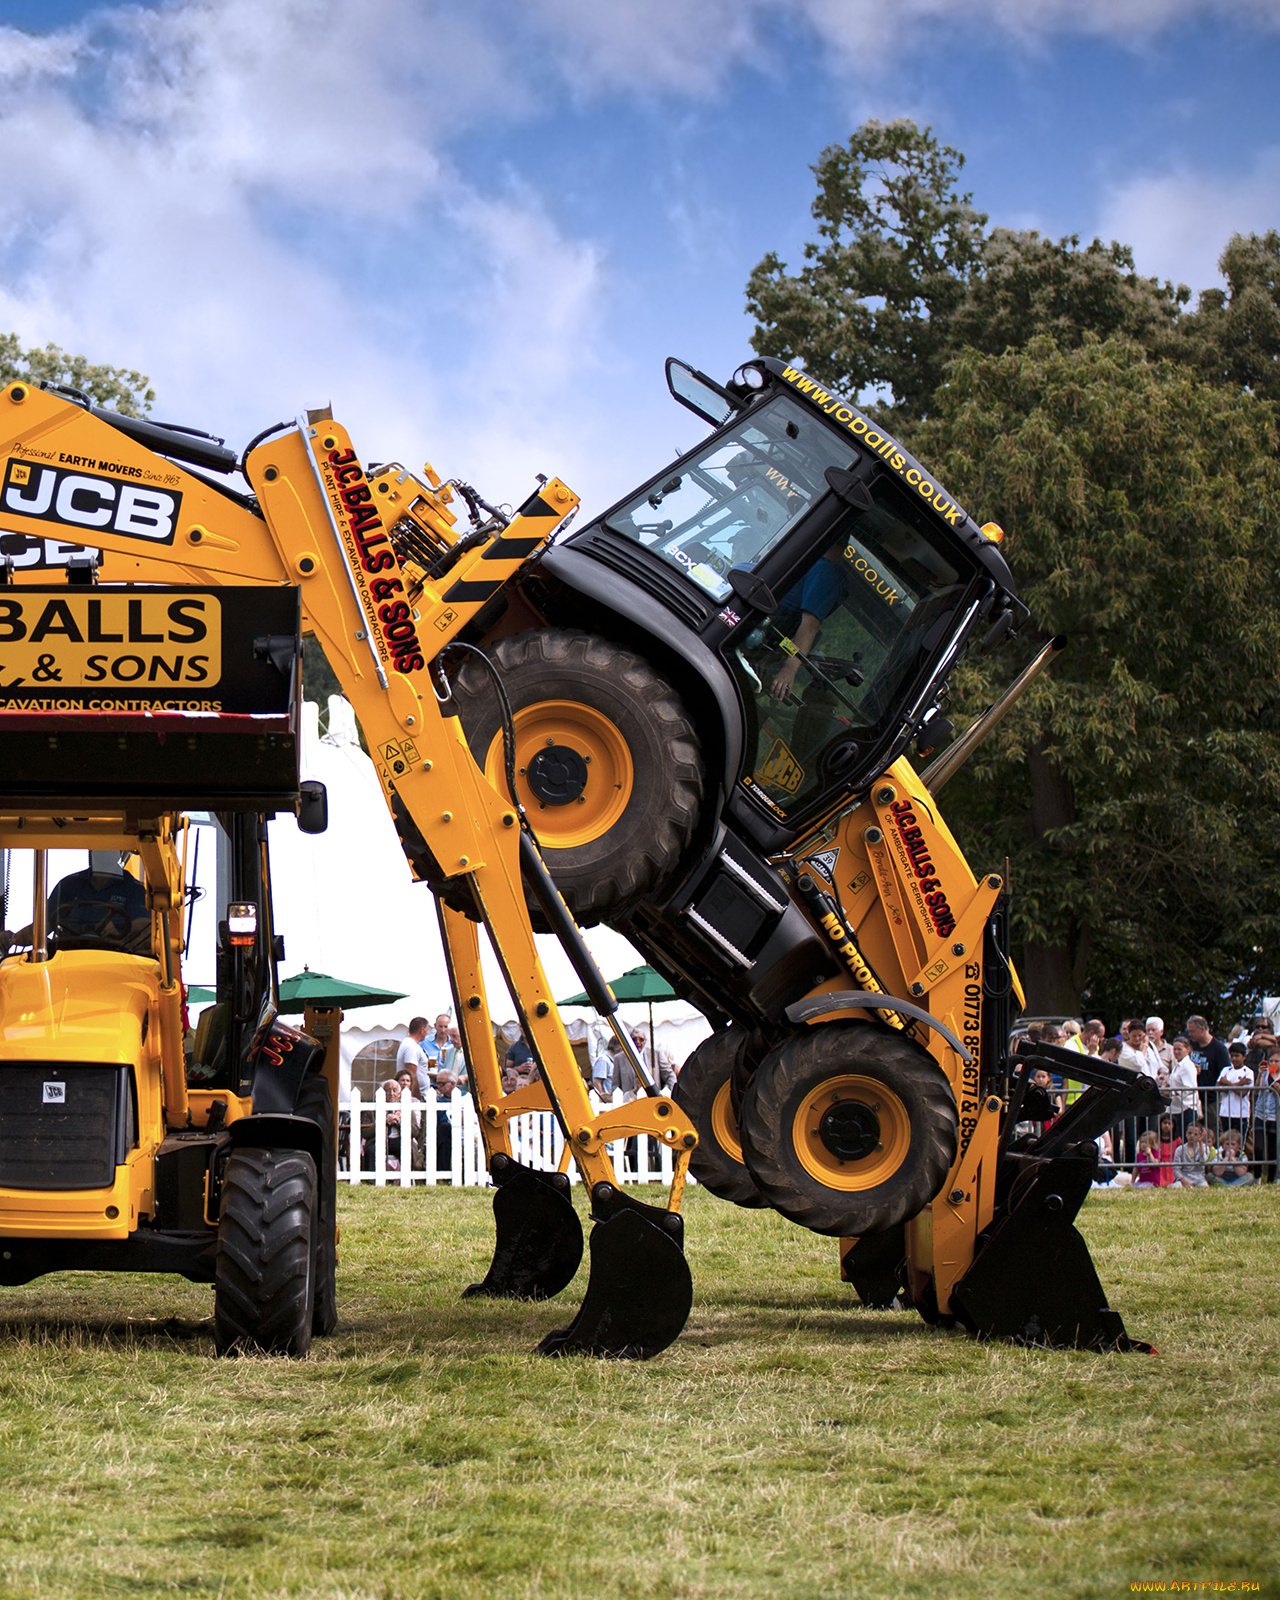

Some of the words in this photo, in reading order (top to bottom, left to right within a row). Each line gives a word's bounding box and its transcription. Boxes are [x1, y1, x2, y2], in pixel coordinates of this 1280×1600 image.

[58, 453, 96, 469] EARTH
[98, 461, 143, 478] MOVERS
[781, 366, 962, 526] www.jcballs.co.uk
[5, 468, 175, 539] JCB
[329, 449, 395, 574] J.C.BALLS
[321, 461, 337, 491] PLANT
[343, 529, 367, 589] EXCAVATION
[361, 589, 389, 662] CONTRACTORS
[369, 577, 404, 603] &
[378, 600, 425, 674] SONS
[31, 653, 63, 682] &
[84, 655, 210, 682] SONS
[92, 699, 223, 712] CONTRACTORS
[765, 747, 802, 791] JCB
[884, 814, 893, 825] OF
[890, 828, 914, 880] AMBERGATE
[909, 882, 935, 935] DERBYSHIRE
[919, 877, 941, 894] &
[820, 911, 845, 941] NO
[925, 890, 957, 939] SONS
[964, 984, 981, 1032] 01773
[960, 1100, 978, 1113] &
